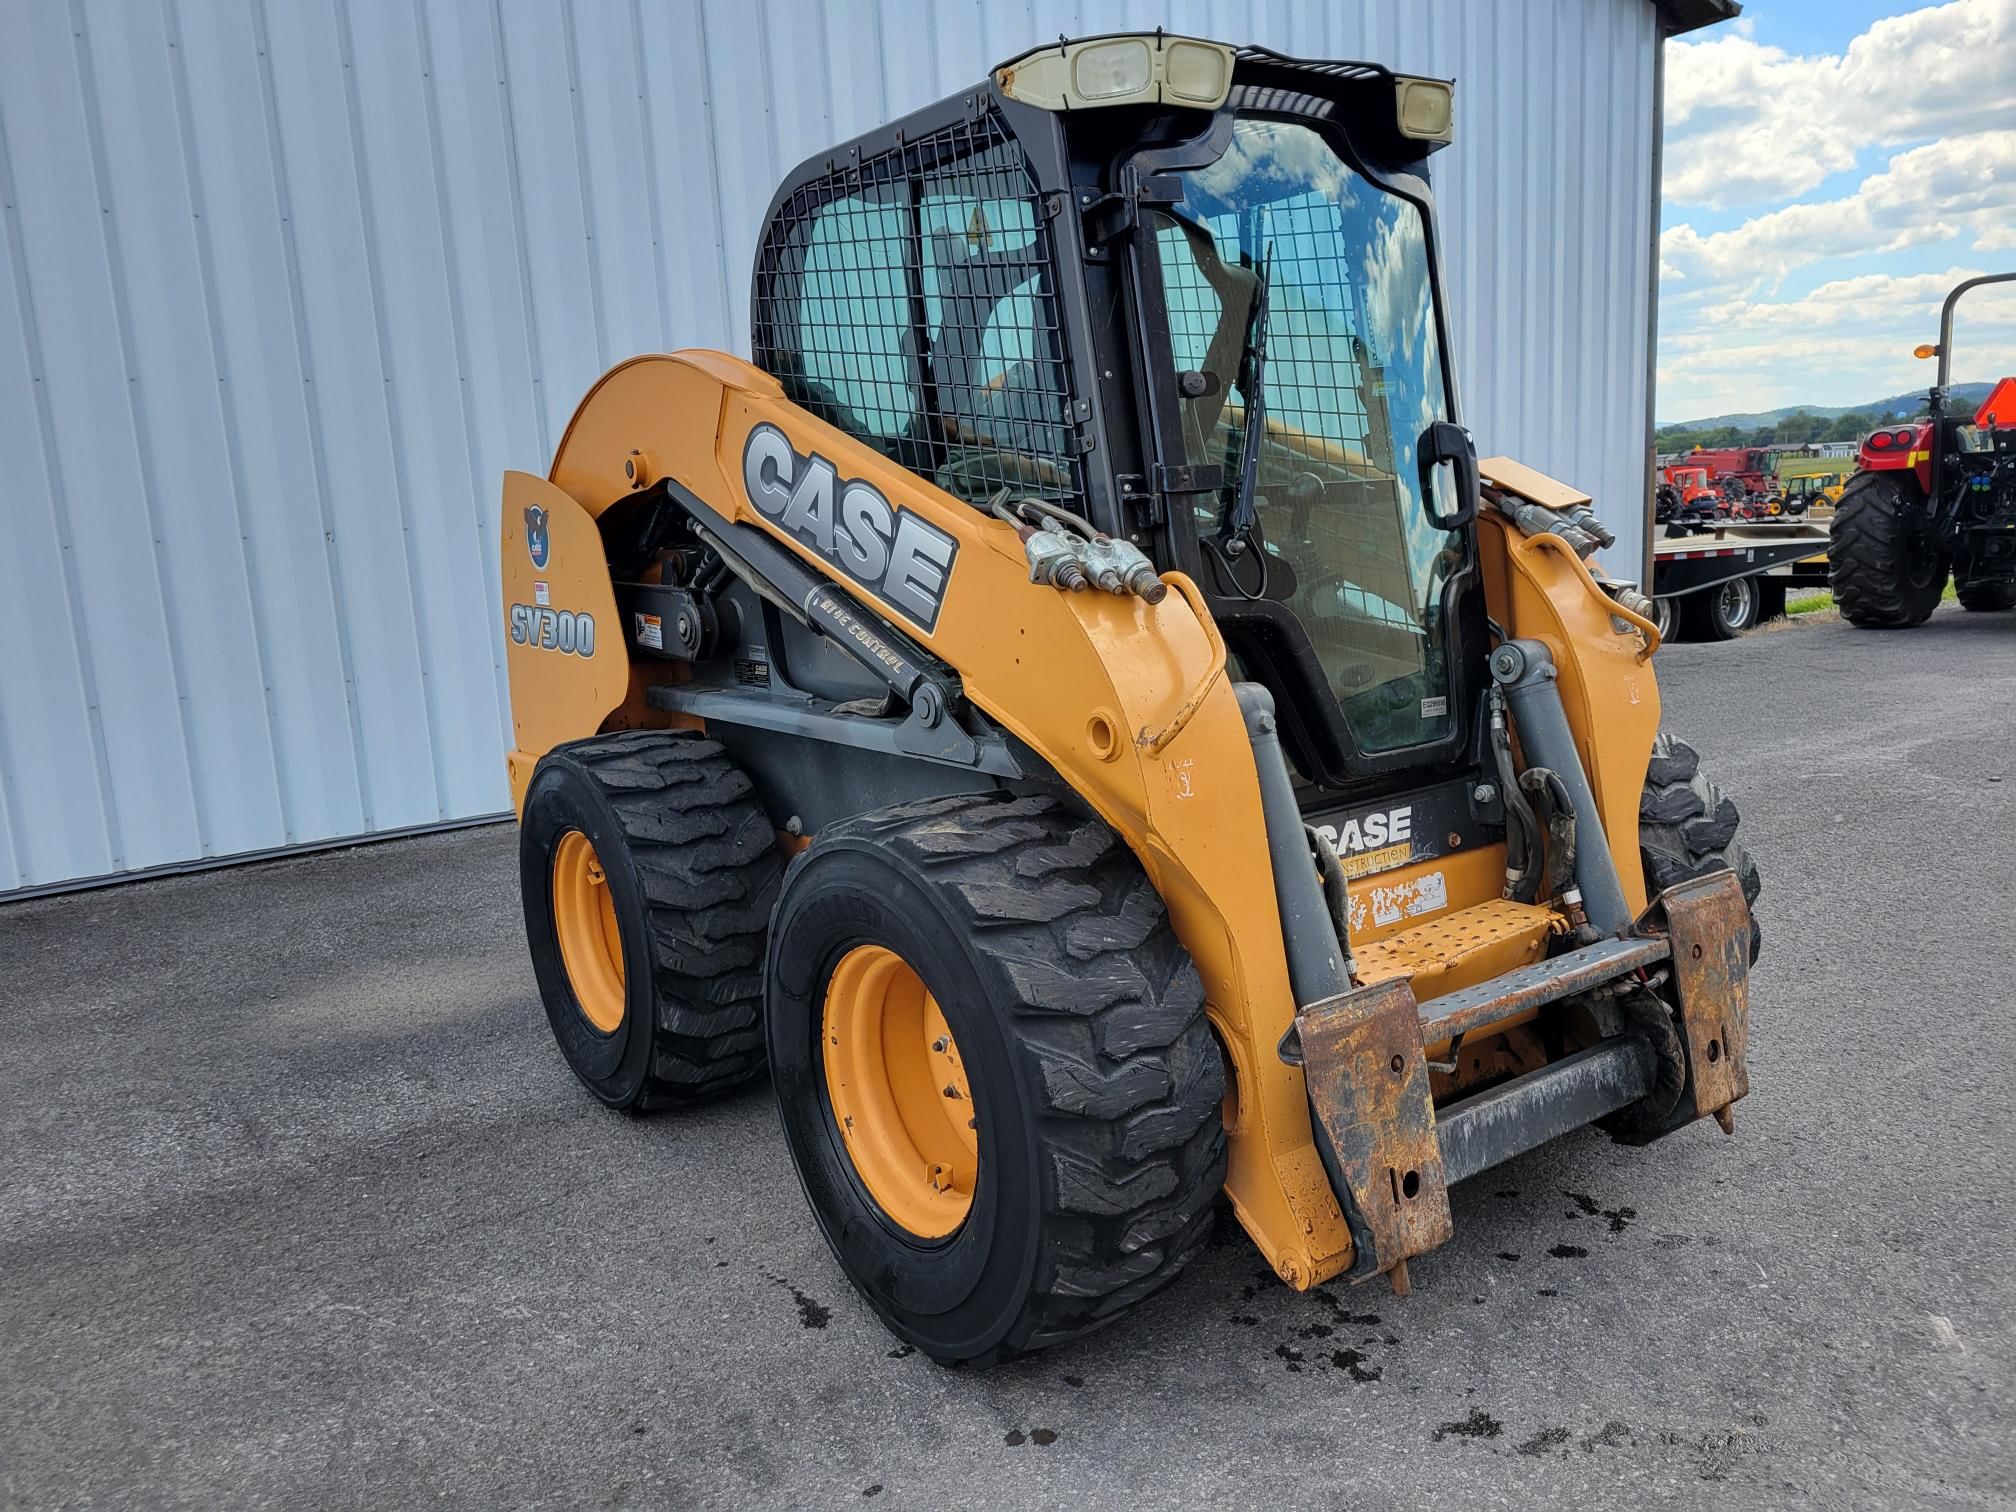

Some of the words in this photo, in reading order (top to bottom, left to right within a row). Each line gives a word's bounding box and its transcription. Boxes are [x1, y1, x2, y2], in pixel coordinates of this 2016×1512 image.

[744, 428, 954, 626] CASE
[511, 604, 595, 658] SV300
[1341, 848, 1408, 873] NSTRUCTION
